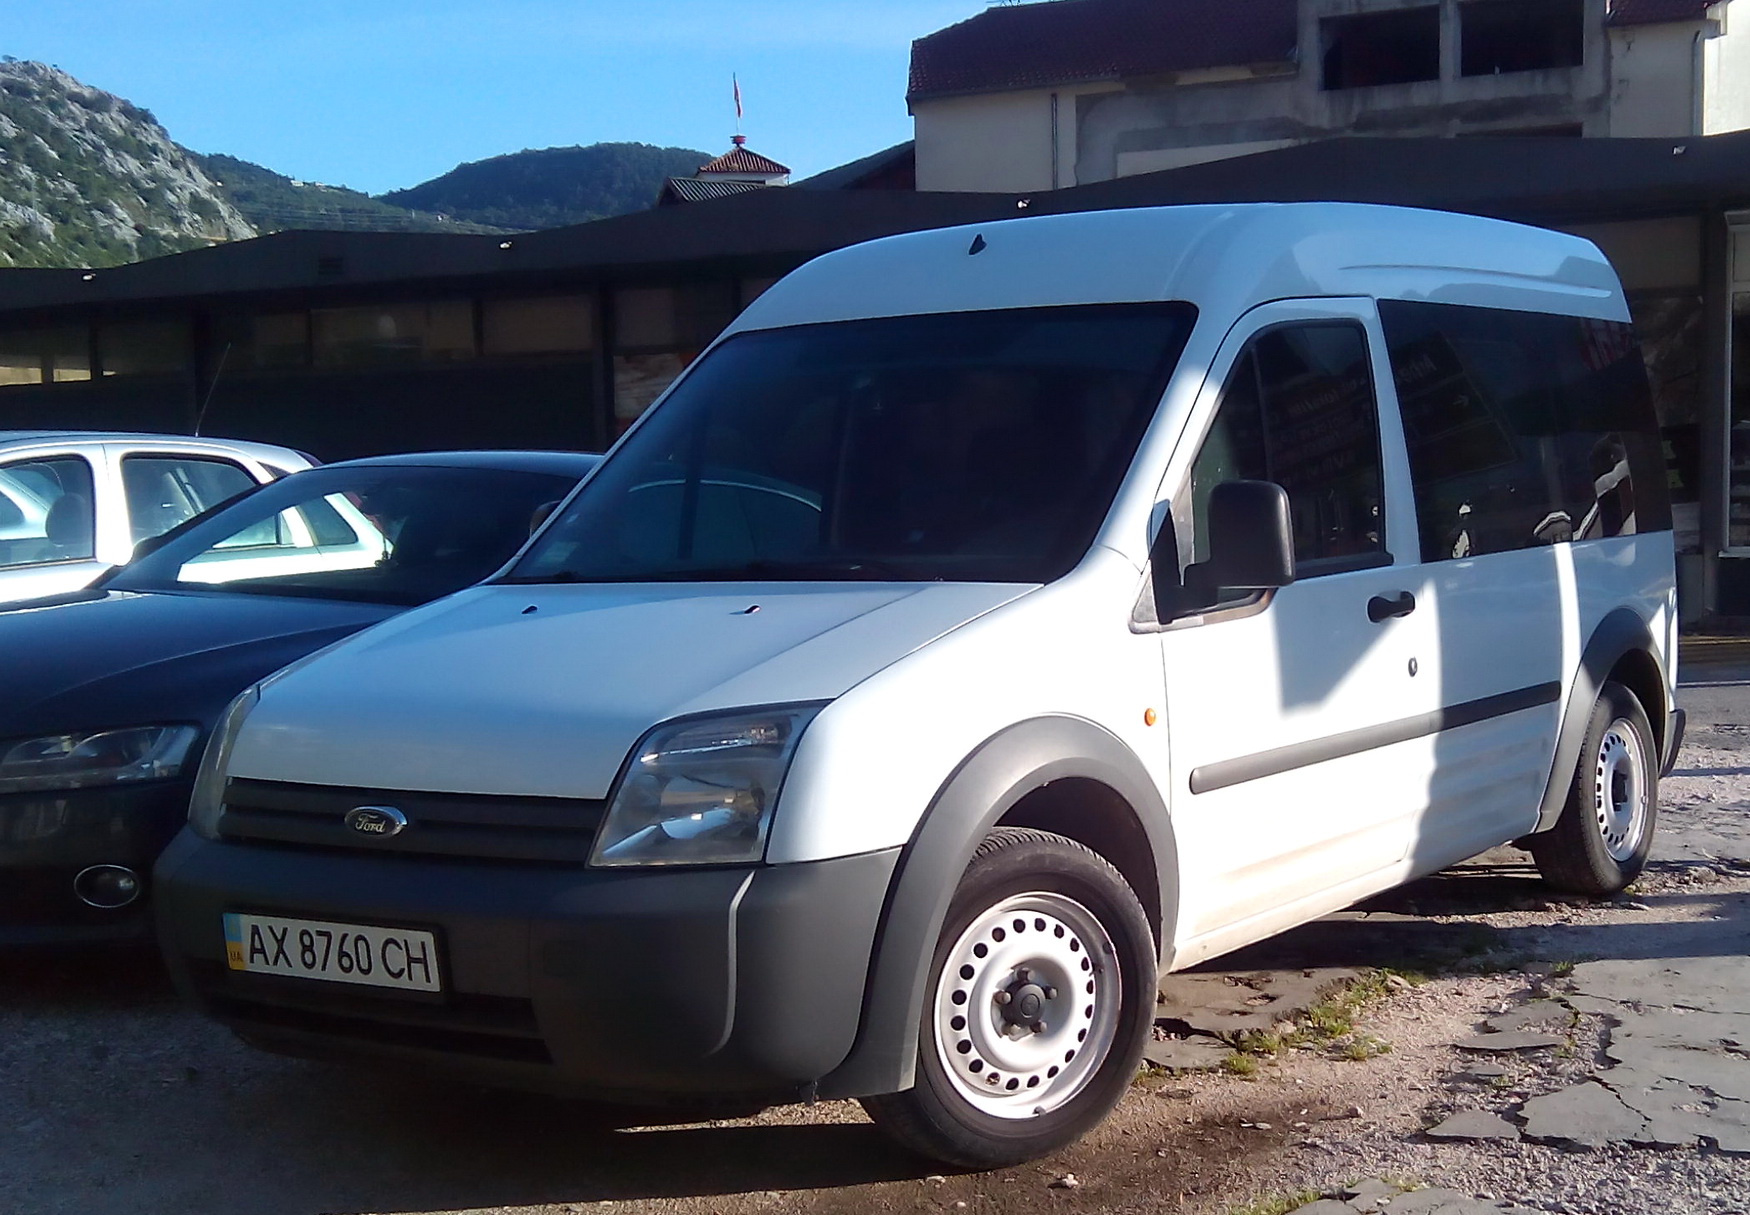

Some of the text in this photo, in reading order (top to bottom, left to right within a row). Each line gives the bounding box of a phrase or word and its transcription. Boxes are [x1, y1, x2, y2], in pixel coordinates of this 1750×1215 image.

[355, 812, 387, 833] Ford
[229, 950, 243, 963] UA
[249, 924, 432, 984] AX 8760 CH
